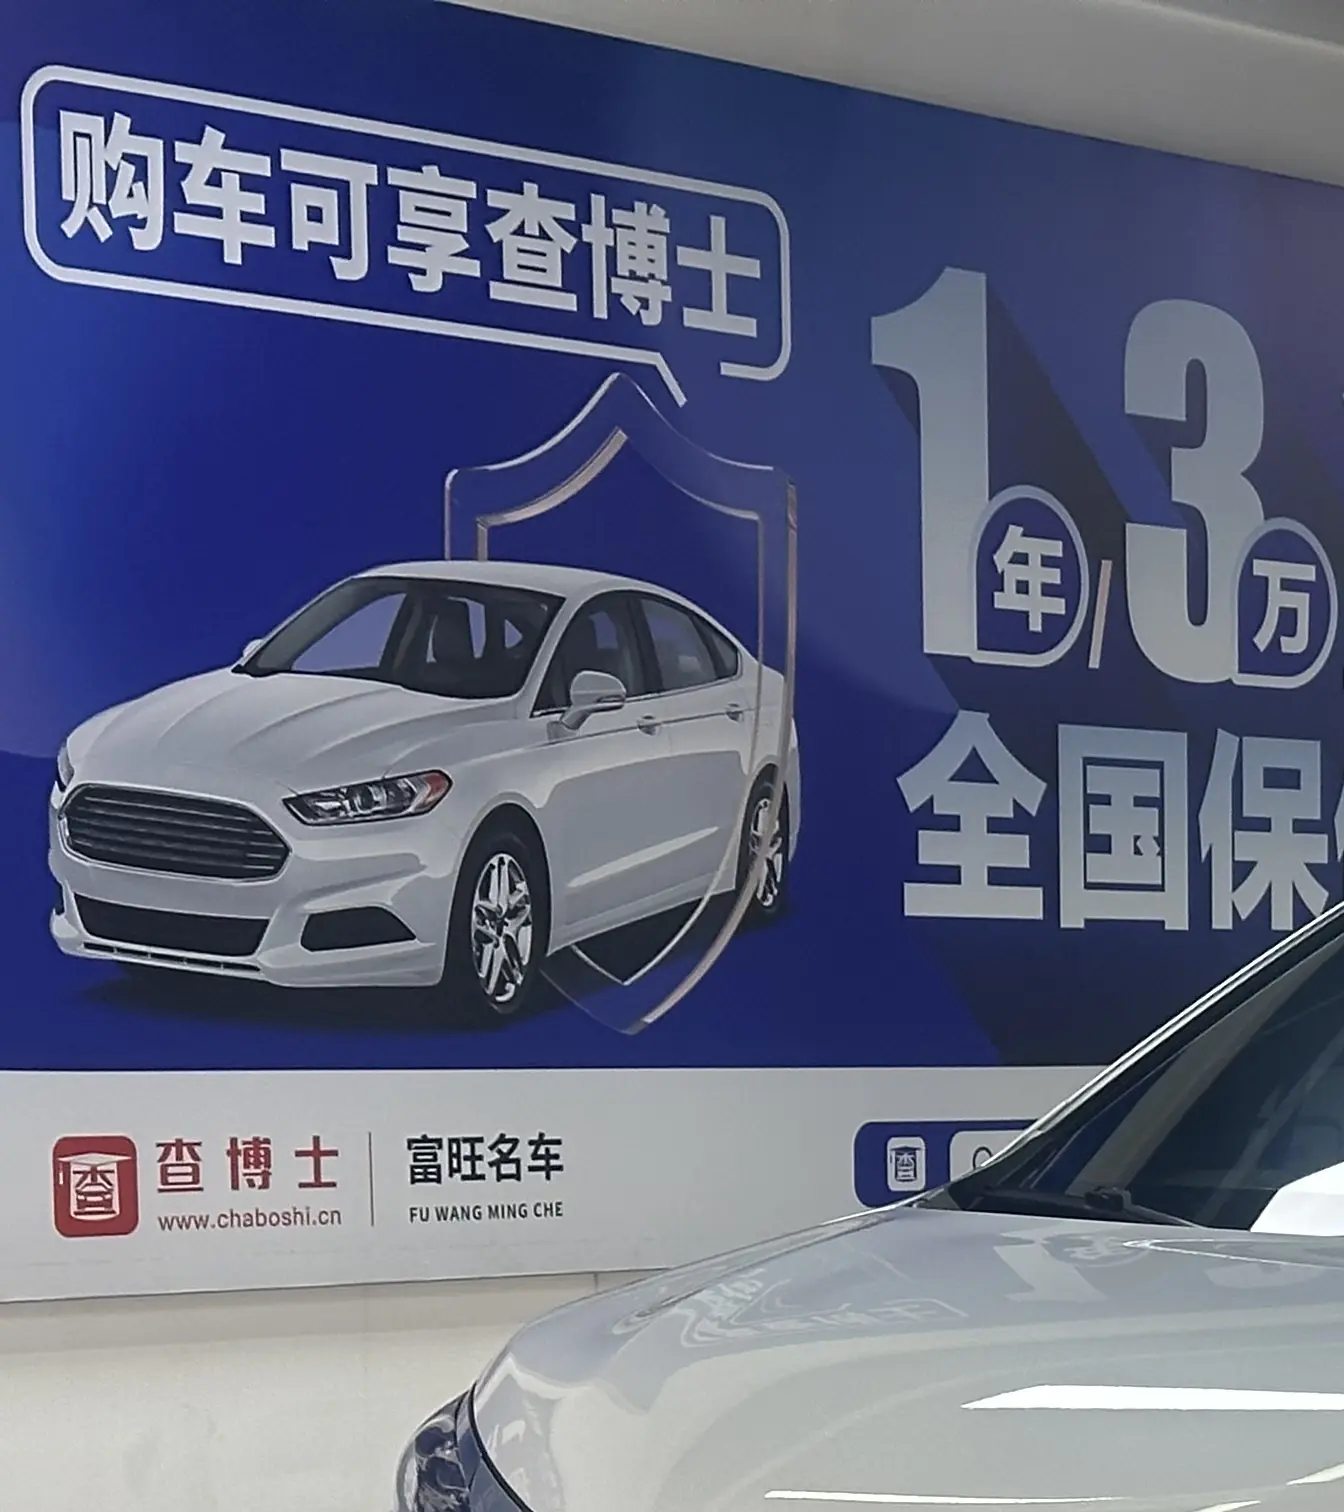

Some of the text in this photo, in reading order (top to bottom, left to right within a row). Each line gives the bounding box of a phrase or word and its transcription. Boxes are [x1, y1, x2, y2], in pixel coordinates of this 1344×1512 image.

[59, 109, 761, 338] 购车可享查博士
[155, 1135, 339, 1193] 查博士
[406, 1132, 564, 1185] 富旺名车
[157, 1206, 342, 1232] www.chaboshi.cn
[409, 1201, 564, 1224] FU WANG MING CHE
